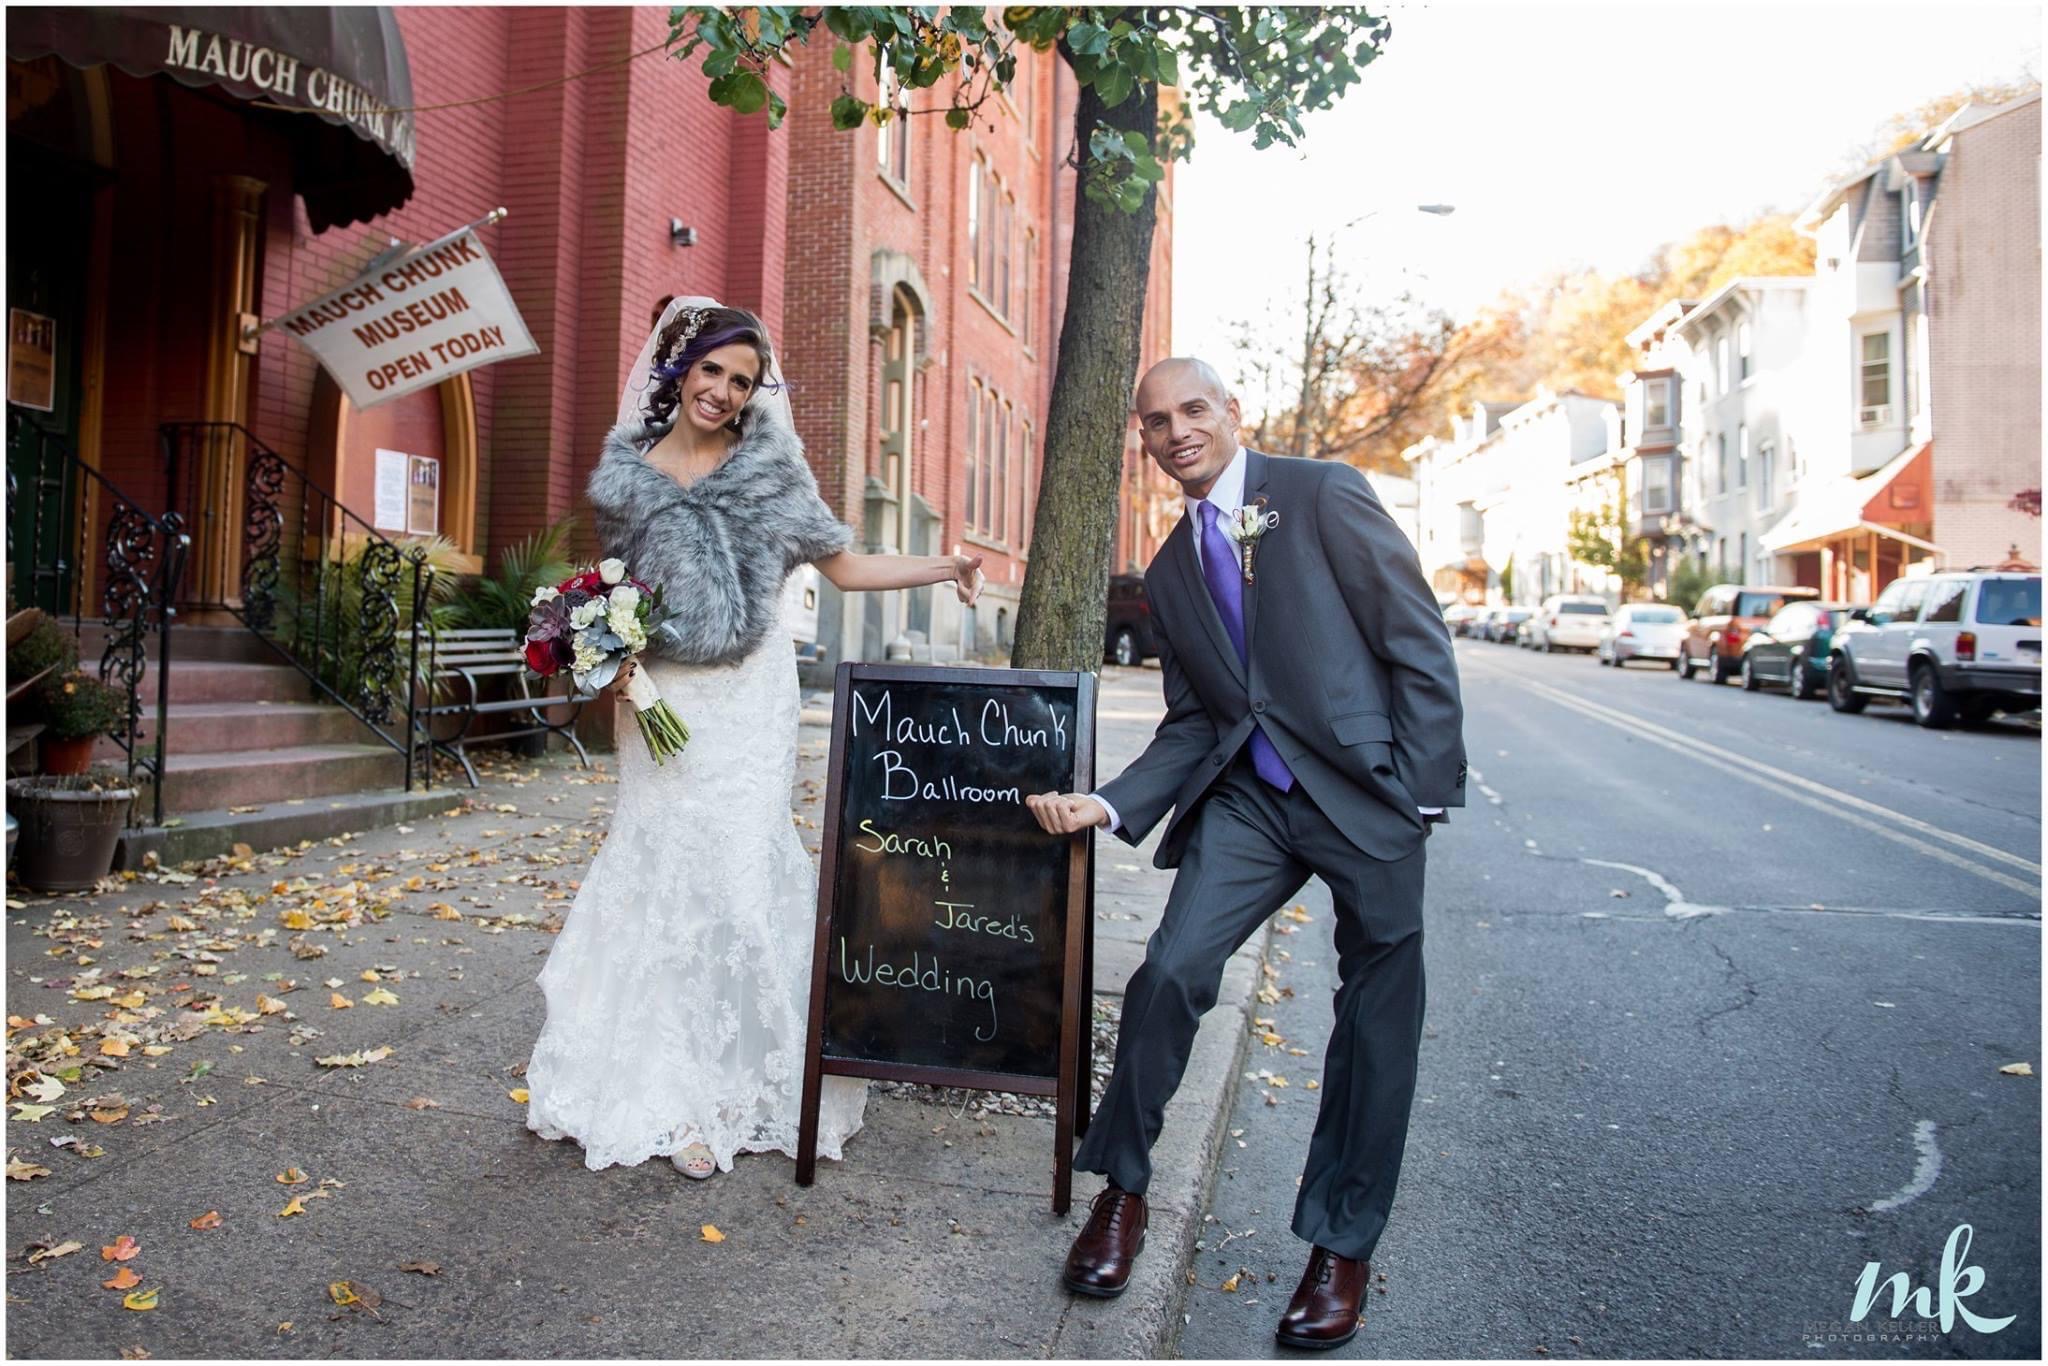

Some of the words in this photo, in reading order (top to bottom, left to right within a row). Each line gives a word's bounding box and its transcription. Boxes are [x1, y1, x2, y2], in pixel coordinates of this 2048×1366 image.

[164, 25, 299, 96] MAUCH
[307, 67, 388, 140] CHUNK
[285, 282, 385, 336] MAUCH
[381, 236, 482, 293] CHUNK
[352, 287, 470, 348] MUSEUM
[366, 351, 432, 390] OPEN
[430, 325, 506, 365] TODAY
[852, 690, 970, 745] Mauch
[981, 699, 1067, 751] Chunk
[873, 750, 1020, 805] Ballroom
[856, 819, 951, 860] Sarah
[934, 901, 1034, 943] Jared's
[841, 936, 997, 1042] Wedding
